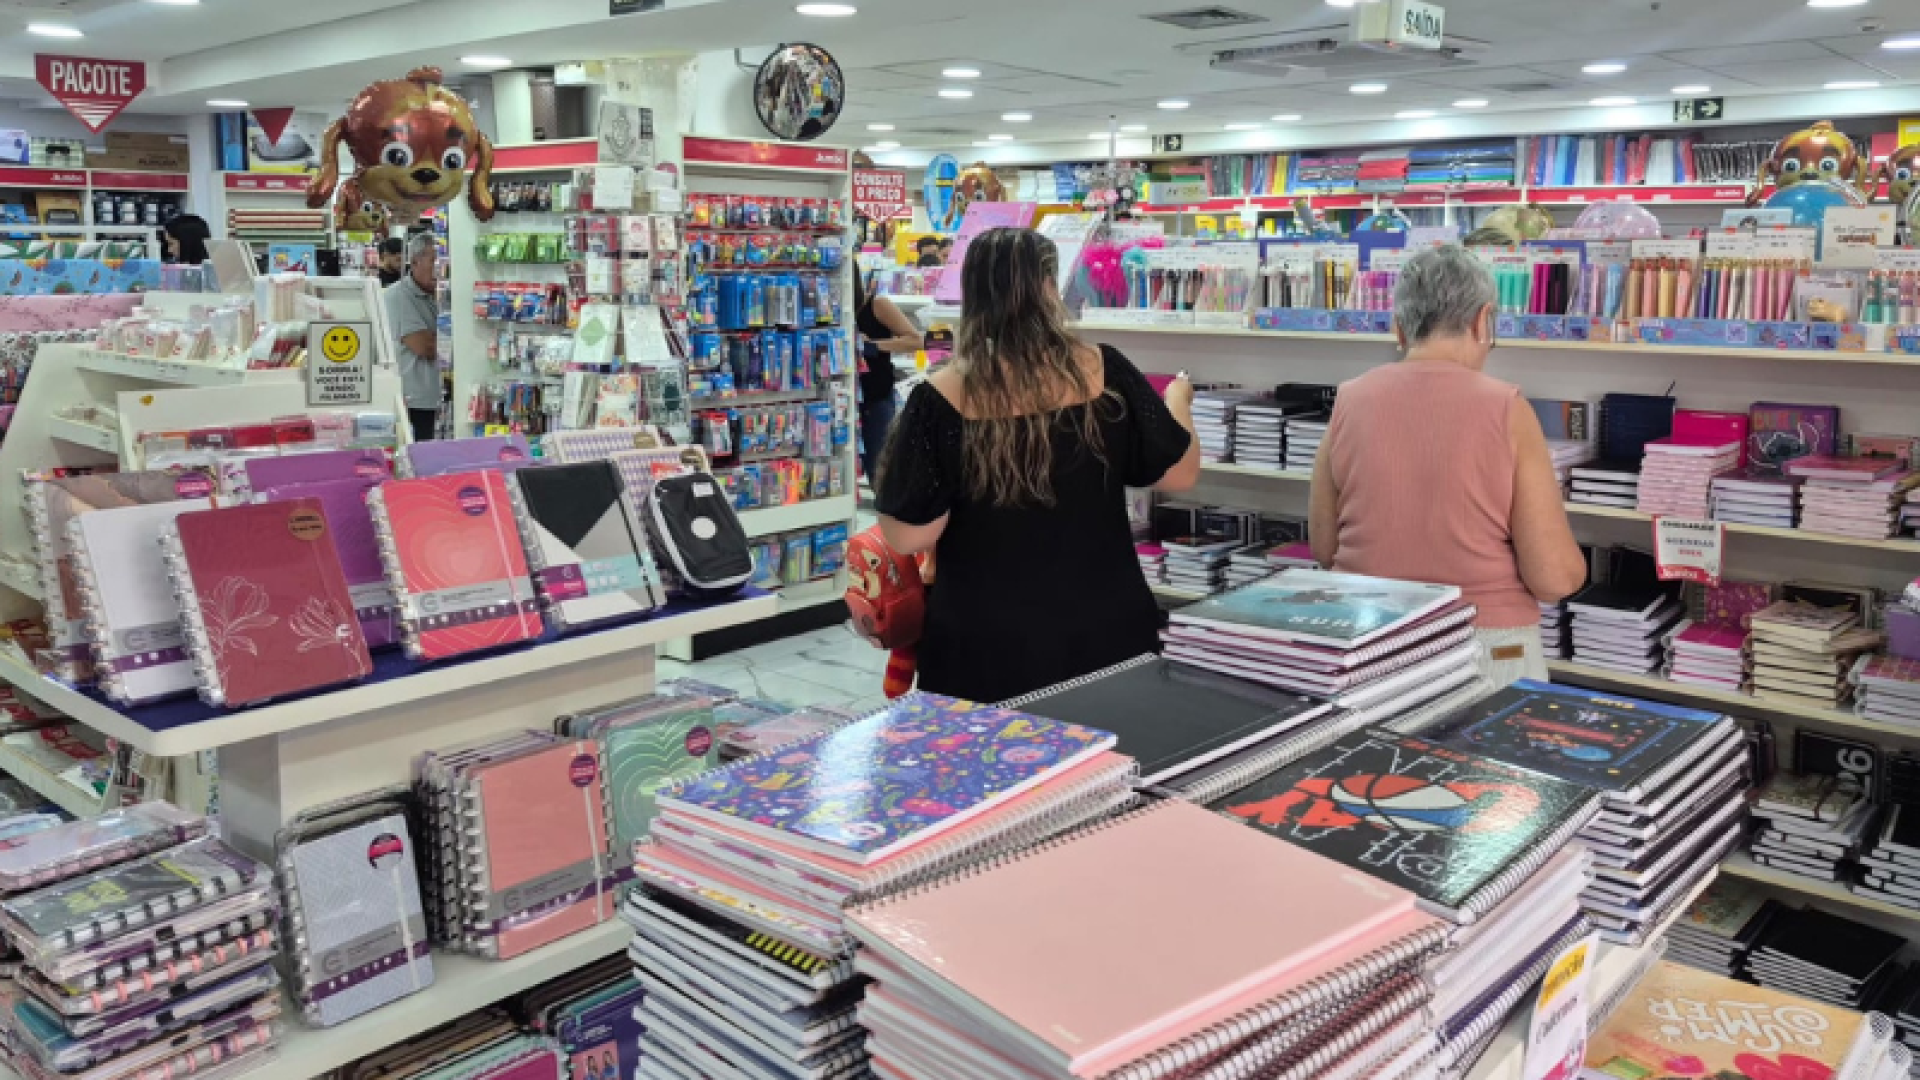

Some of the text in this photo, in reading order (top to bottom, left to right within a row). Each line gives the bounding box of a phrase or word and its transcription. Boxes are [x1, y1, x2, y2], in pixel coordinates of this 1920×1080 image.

[1404, 8, 1441, 40] SAÍDA
[52, 60, 132, 96] PACOTE
[854, 172, 903, 186] CONSULTE
[868, 187, 901, 201] PREÇO
[318, 366, 363, 374] SORRIA!
